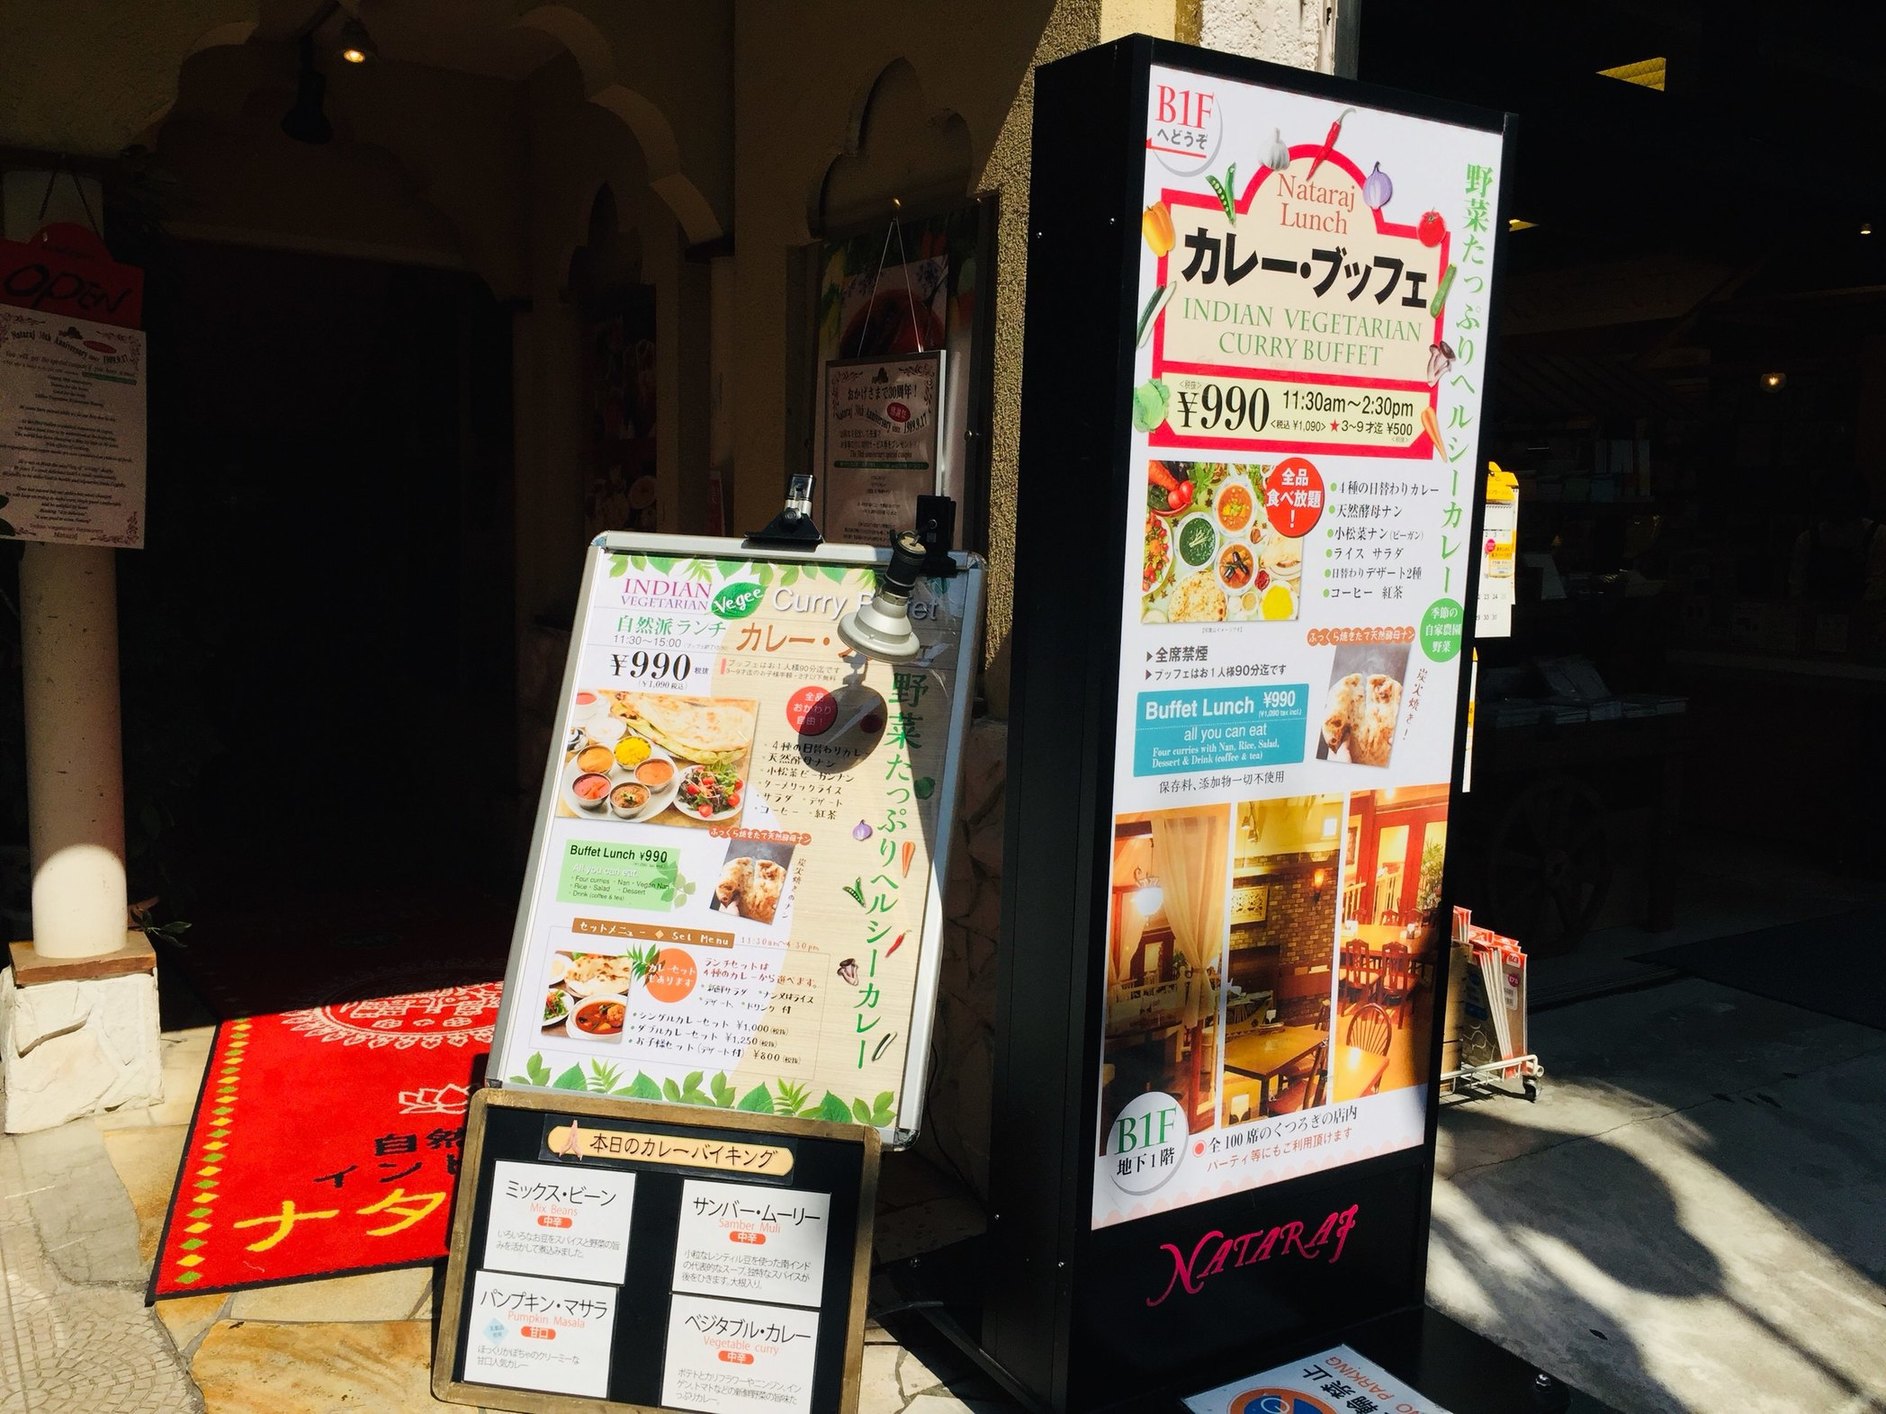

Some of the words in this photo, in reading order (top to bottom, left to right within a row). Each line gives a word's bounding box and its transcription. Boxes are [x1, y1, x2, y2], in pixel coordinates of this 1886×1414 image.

[1156, 85, 1214, 129] B1F
[1157, 127, 1208, 150] へどうぞ
[1277, 173, 1355, 213] Nataraj
[1280, 203, 1348, 234] Lunch
[1181, 227, 1427, 309] カレー・ブッフェ
[1183, 297, 1273, 329] INDIAN
[1284, 308, 1422, 343] VEGETARIAN
[1219, 331, 1297, 360] CURRY
[1303, 339, 1384, 366] BUFFET
[1441, 163, 1494, 594] 野菜たっぷりヘルシーカレー
[1177, 383, 1270, 432] ¥990
[1386, 423, 1413, 436] ¥500
[1281, 467, 1309, 487] 全品
[1266, 489, 1321, 509] 食べ放題
[1336, 504, 1403, 519] 天然酵母ナン
[1334, 547, 1364, 560] ライス
[1373, 547, 1404, 560] サラダ
[624, 578, 712, 599] INDIAN
[1331, 587, 1373, 599] コーヒー
[1382, 585, 1404, 599] 紅茶
[621, 595, 709, 611] VEGETARIAN
[713, 587, 764, 615] Vegee
[773, 588, 848, 619] Curry
[1431, 606, 1458, 620] 季節の
[617, 615, 726, 638] 自然派ランチ
[1425, 623, 1462, 637] 自家農園
[1155, 646, 1209, 664] 全席禁煙
[1432, 640, 1451, 653] 野菜
[611, 651, 691, 681] ¥990
[805, 692, 824, 701] 全品
[1145, 699, 1198, 720] Buffet
[1202, 696, 1255, 717] Lunch
[1263, 690, 1296, 708] ¥990
[793, 704, 832, 714] おかわり
[1184, 726, 1197, 741] all
[1200, 728, 1222, 743] you
[1225, 727, 1246, 738] can
[1250, 723, 1267, 737] eat
[1152, 758, 1180, 768] Dessert
[1191, 755, 1214, 765] Drink
[1153, 747, 1170, 757] Four
[1173, 747, 1199, 757] curries
[1201, 744, 1217, 754] with
[570, 845, 600, 857] Buffet
[603, 848, 635, 859] Lunch
[640, 849, 667, 863] ¥990
[854, 672, 929, 1070] 野菜たっぷりヘルシーカレー
[672, 931, 692, 942] Set
[700, 933, 729, 947] Menu
[1115, 1105, 1177, 1155] B1F
[590, 1133, 778, 1168] 本日のカレーバイキング
[1117, 1148, 1175, 1176] 地下1階
[505, 1180, 617, 1207] ミックス・ビーン
[530, 1202, 546, 1213] Mix
[551, 1204, 578, 1216] Beans
[693, 1197, 821, 1226] サンバー・ムーリー
[718, 1218, 755, 1231] Samber
[759, 1221, 781, 1233] Muli
[1145, 1204, 1359, 1307] NATARAJ
[480, 1289, 607, 1320] パンプキン・マサラ
[507, 1311, 548, 1325] Pumpkin
[554, 1316, 586, 1329] Masala
[685, 1314, 811, 1344] ベジタブル・カレー
[704, 1335, 751, 1350] Vegetable
[755, 1343, 779, 1356] curry
[1325, 1356, 1395, 1400] PARKING
